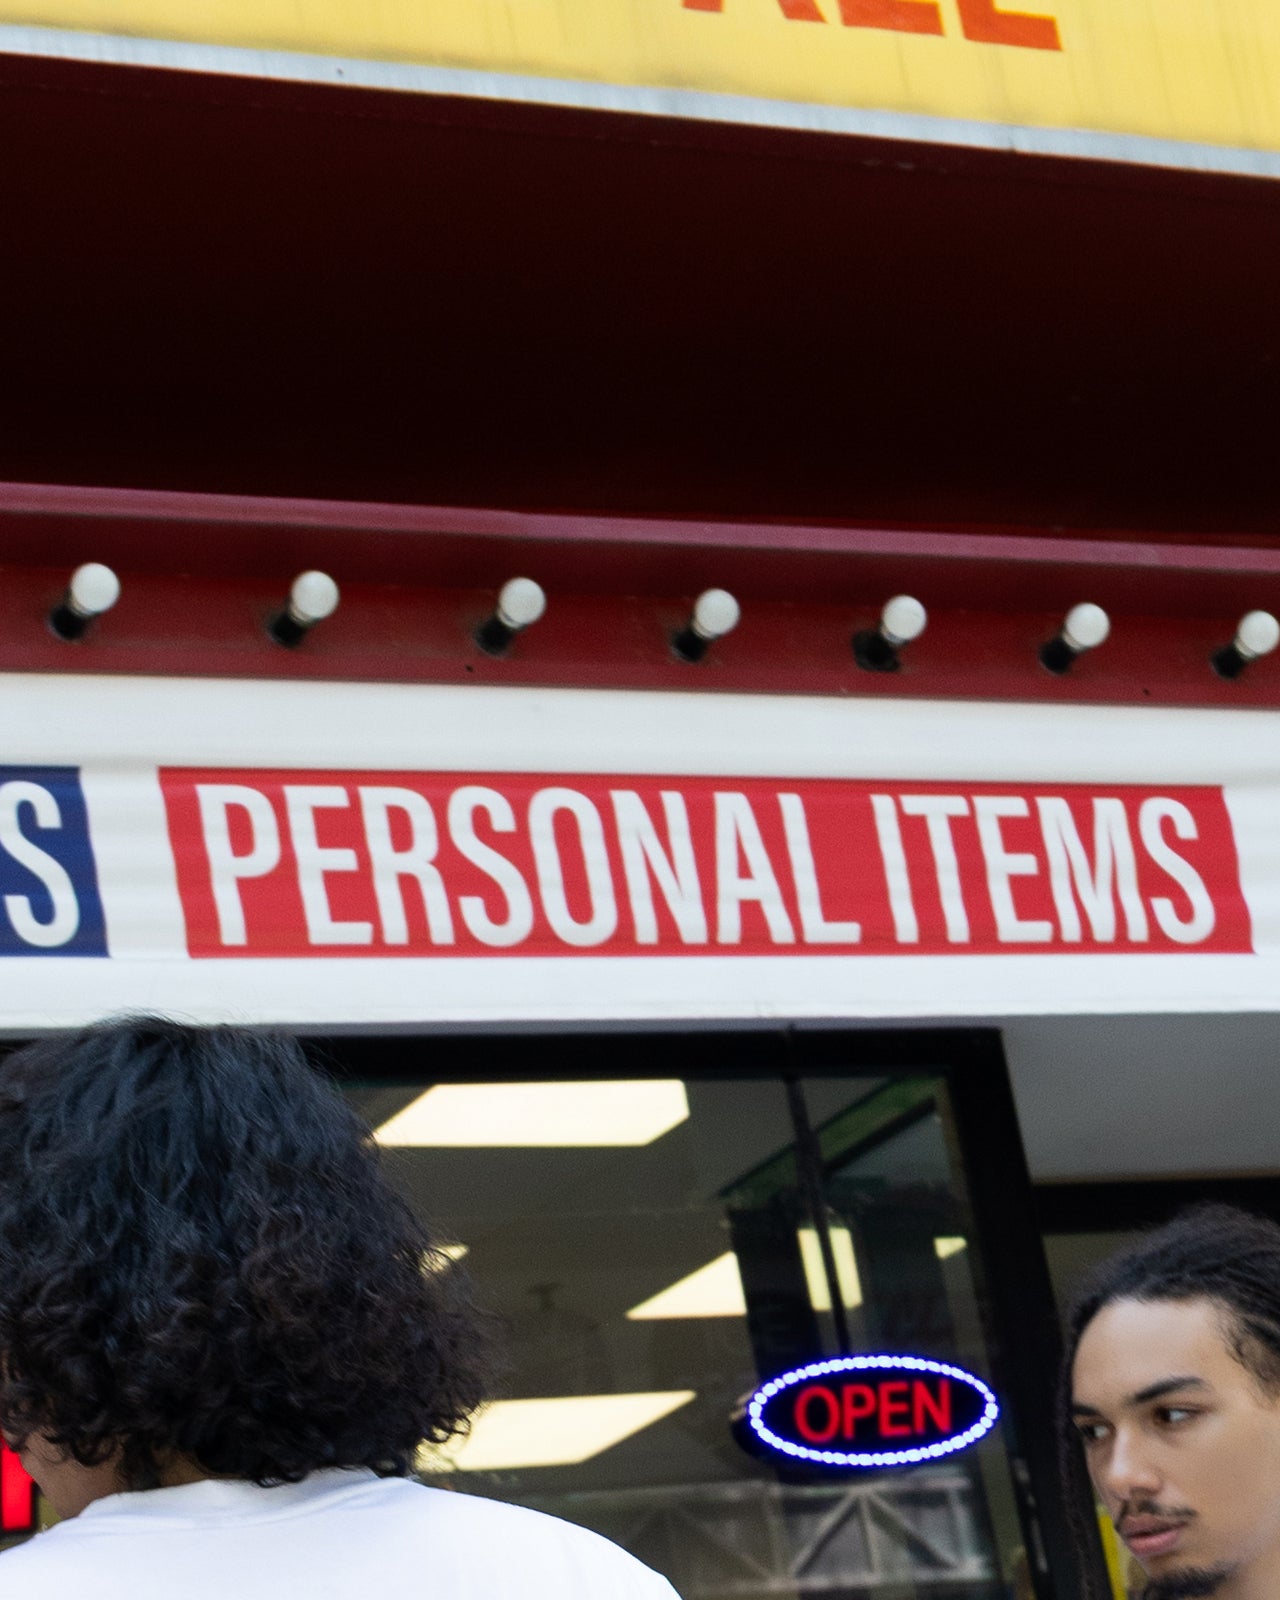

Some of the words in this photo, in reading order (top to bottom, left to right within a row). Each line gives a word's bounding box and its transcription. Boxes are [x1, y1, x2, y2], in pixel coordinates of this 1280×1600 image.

[194, 783, 862, 948] PERSONAL
[869, 790, 1217, 945] ITEMS
[794, 1378, 954, 1443] OPEN
